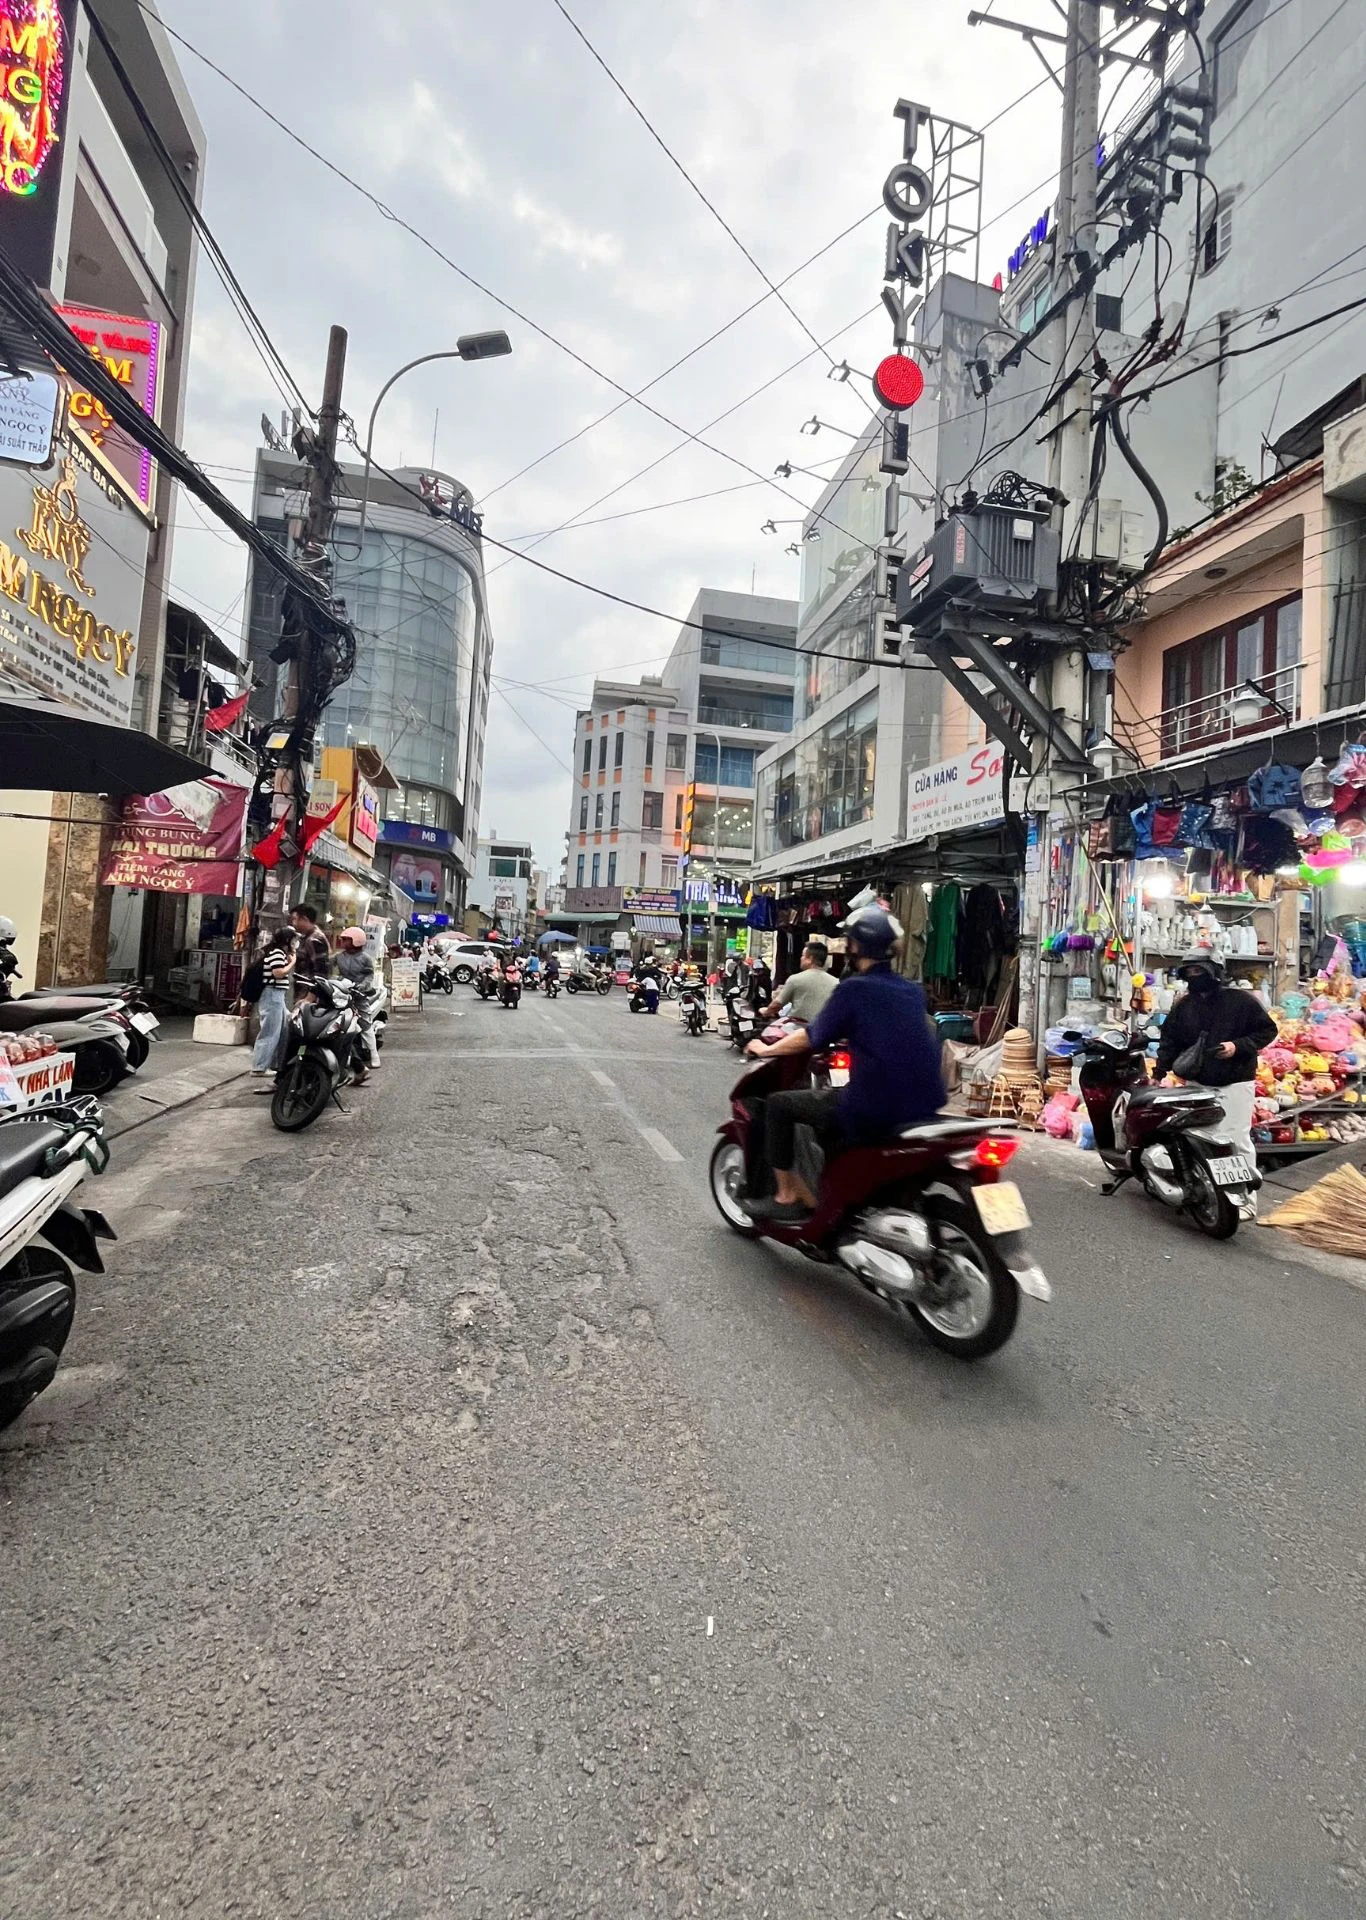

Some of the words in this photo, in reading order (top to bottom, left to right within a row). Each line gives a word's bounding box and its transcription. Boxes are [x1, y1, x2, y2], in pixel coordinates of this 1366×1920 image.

[915, 773, 931, 794] CỬA
[933, 766, 958, 788] HÀNG
[421, 830, 437, 843] MB
[140, 876, 182, 891] NGỌC
[27, 1064, 50, 1095] NHÀ
[53, 1059, 74, 1086] LÀM
